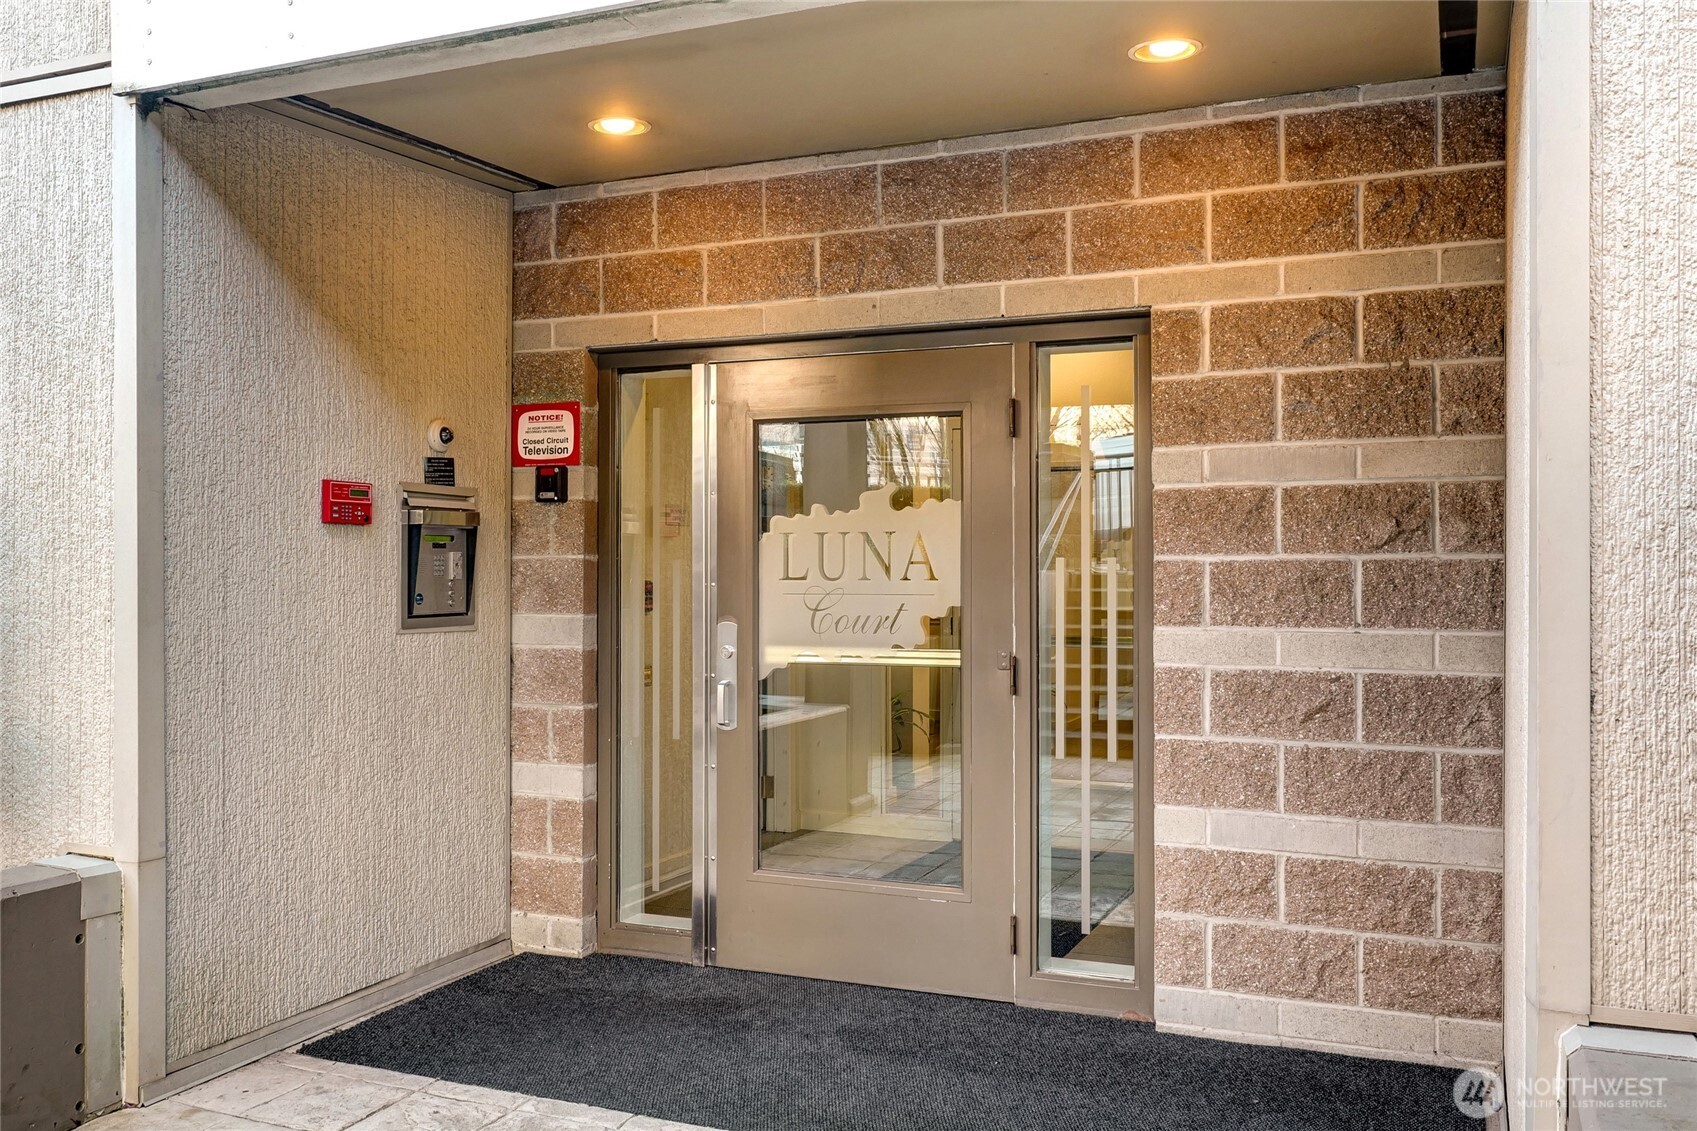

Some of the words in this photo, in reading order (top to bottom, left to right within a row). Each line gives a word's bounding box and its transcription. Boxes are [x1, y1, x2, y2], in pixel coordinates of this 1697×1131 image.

[522, 437, 545, 445] Closed
[522, 445, 569, 455] Television
[778, 530, 939, 582] LUNA
[803, 585, 908, 640] Court
